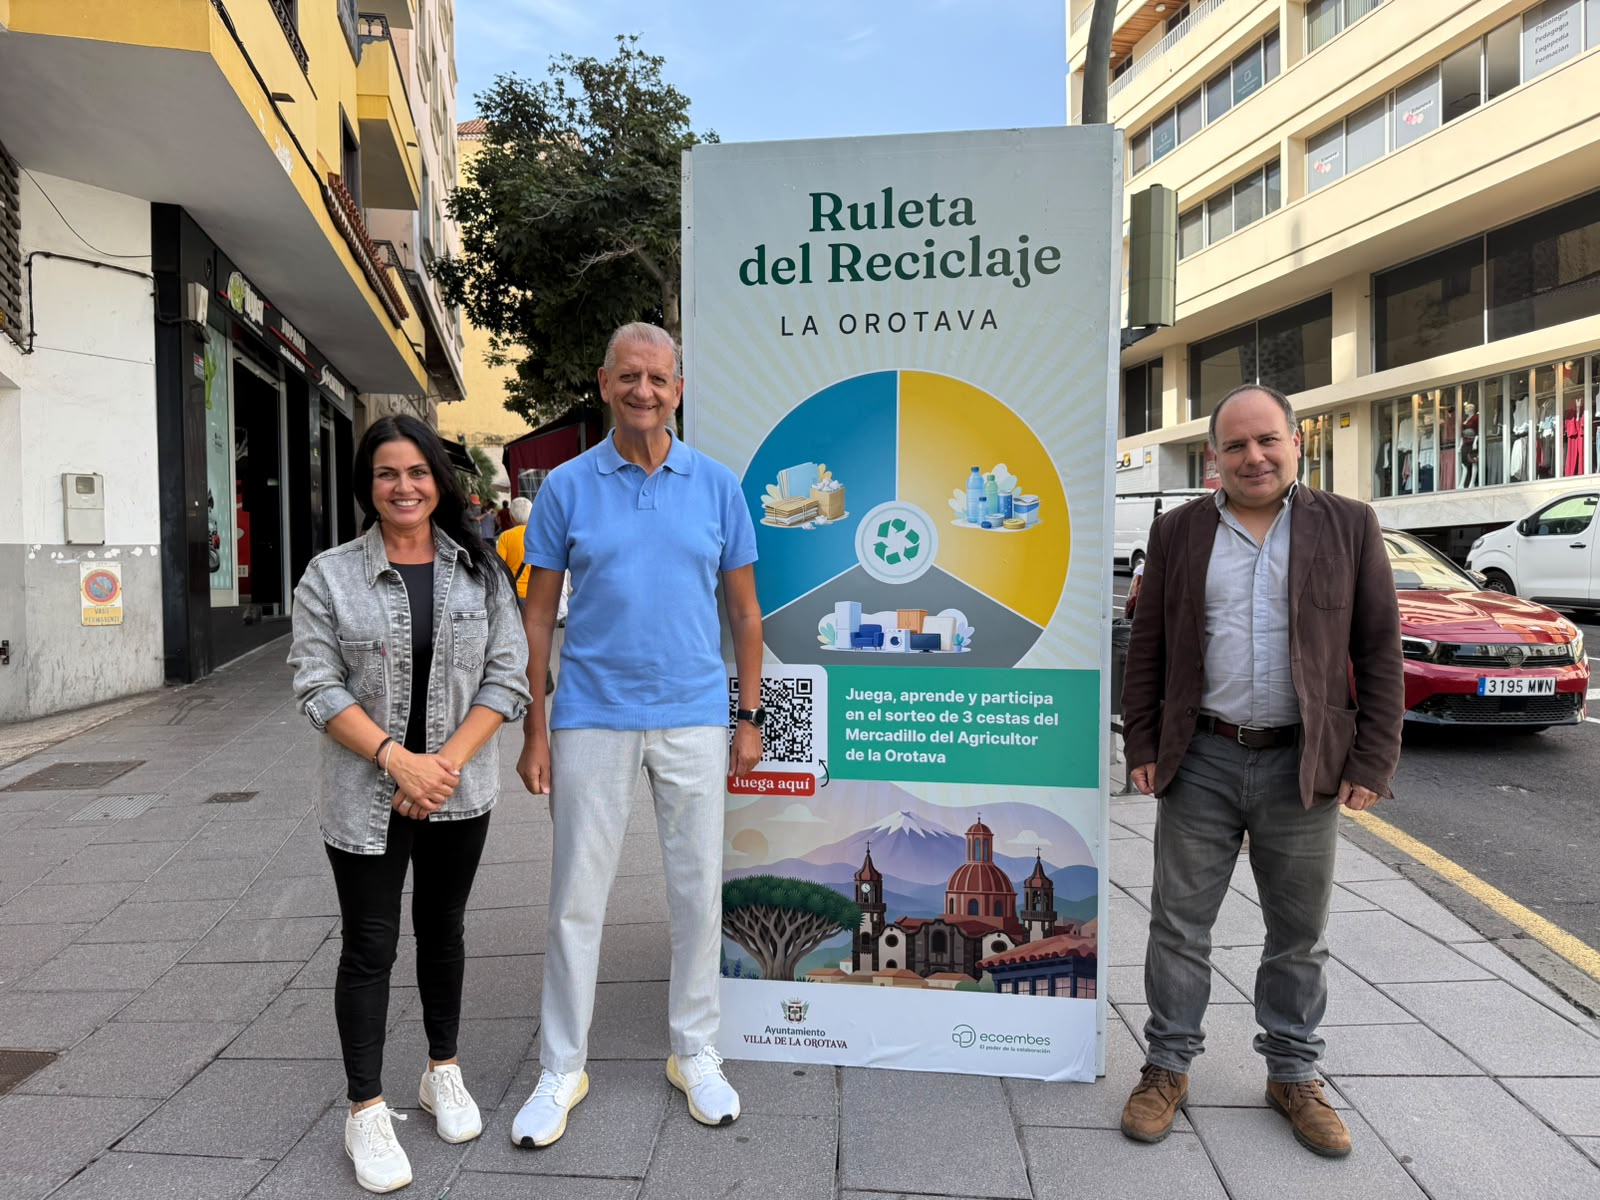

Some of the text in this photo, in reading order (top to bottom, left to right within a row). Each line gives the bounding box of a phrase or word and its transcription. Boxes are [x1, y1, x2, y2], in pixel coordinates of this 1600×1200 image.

[1535, 44, 1569, 65] Formación
[809, 187, 976, 232] Ruleta
[739, 235, 1061, 288] del Reciclaje
[781, 309, 998, 336] LA OROTAVA
[1488, 680, 1523, 693] 3195
[1528, 679, 1553, 693] MWN
[845, 688, 1053, 708] Juega, aprende y participa
[845, 709, 1059, 726] en el sorteo de 3 cestas del
[845, 728, 1038, 747] Mercadillo del Agricultor
[845, 748, 946, 763] de la Orotava
[732, 777, 810, 792] Juega aquí
[764, 1025, 826, 1037] Ayuntamiento
[980, 1033, 1051, 1046] ecoembes
[743, 1035, 848, 1049] VILLA DE LA OROTAVA
